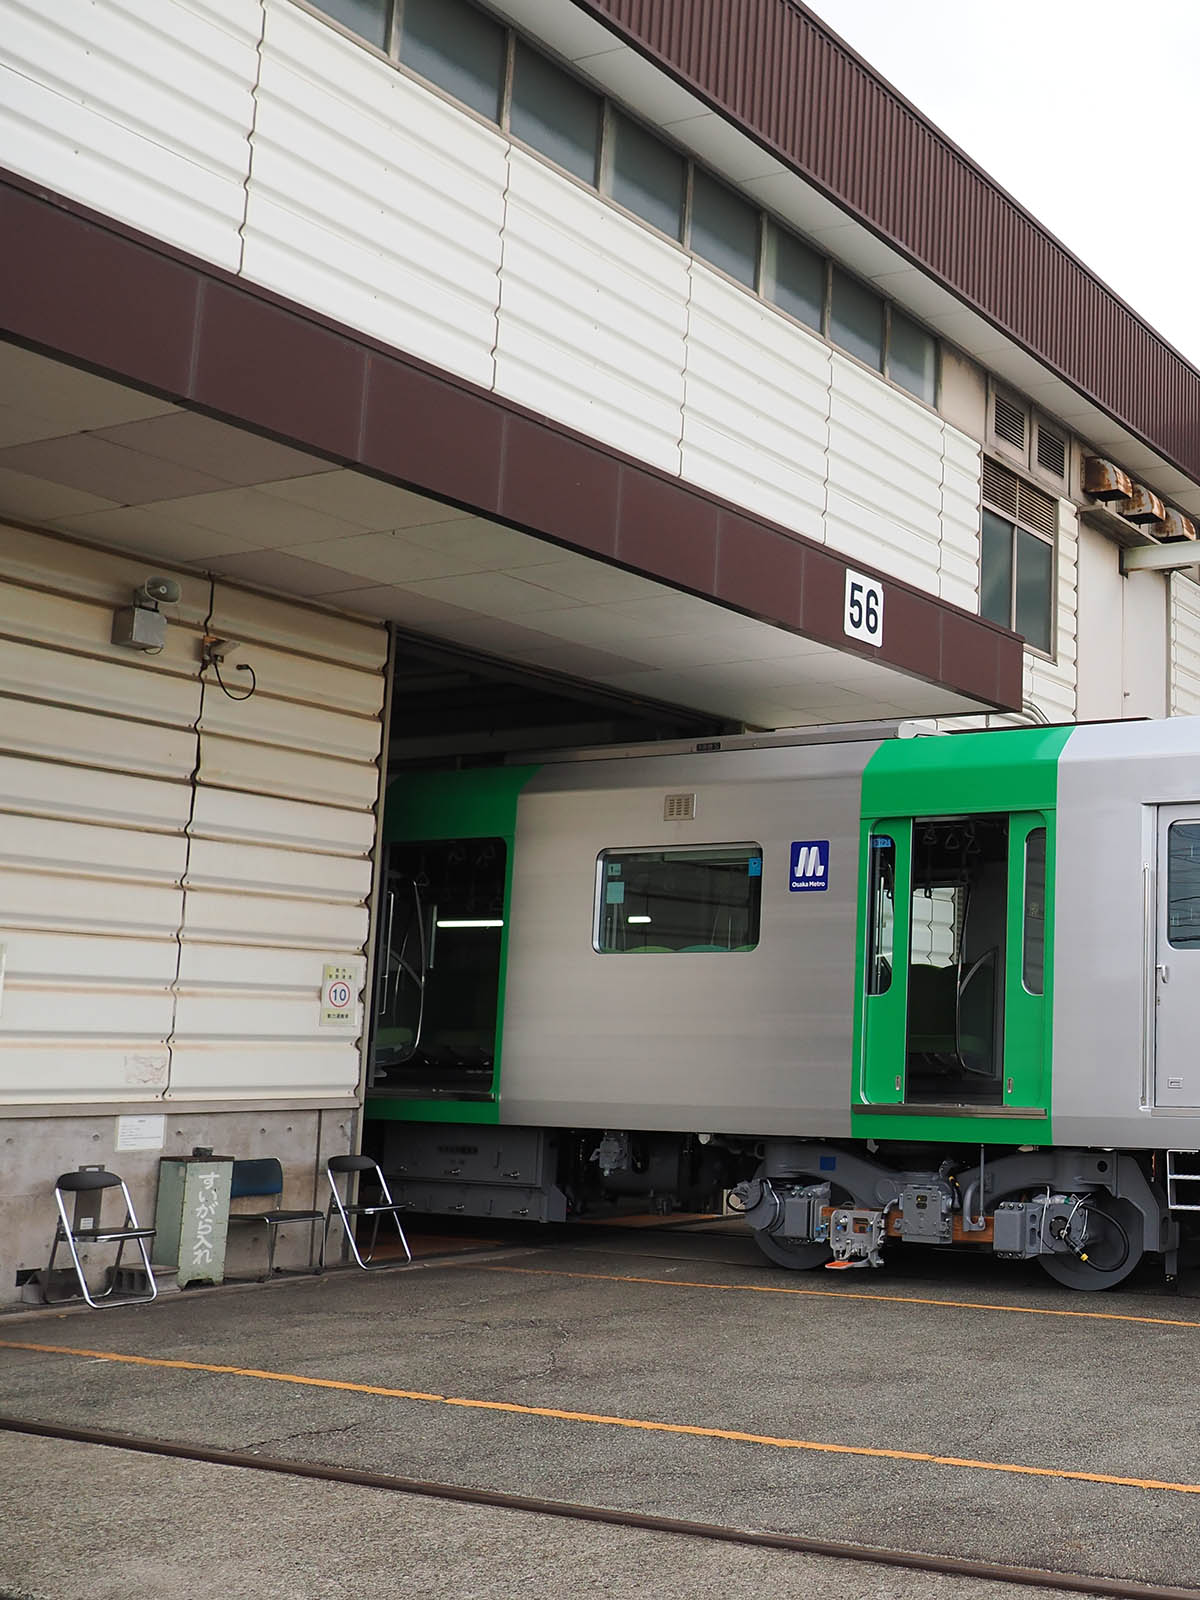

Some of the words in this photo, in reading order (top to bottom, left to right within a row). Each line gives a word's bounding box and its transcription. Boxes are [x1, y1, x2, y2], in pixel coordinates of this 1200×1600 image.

[849, 581, 879, 635] 56
[332, 988, 347, 1002] 10
[193, 1171, 220, 1265] すいがら入れ
